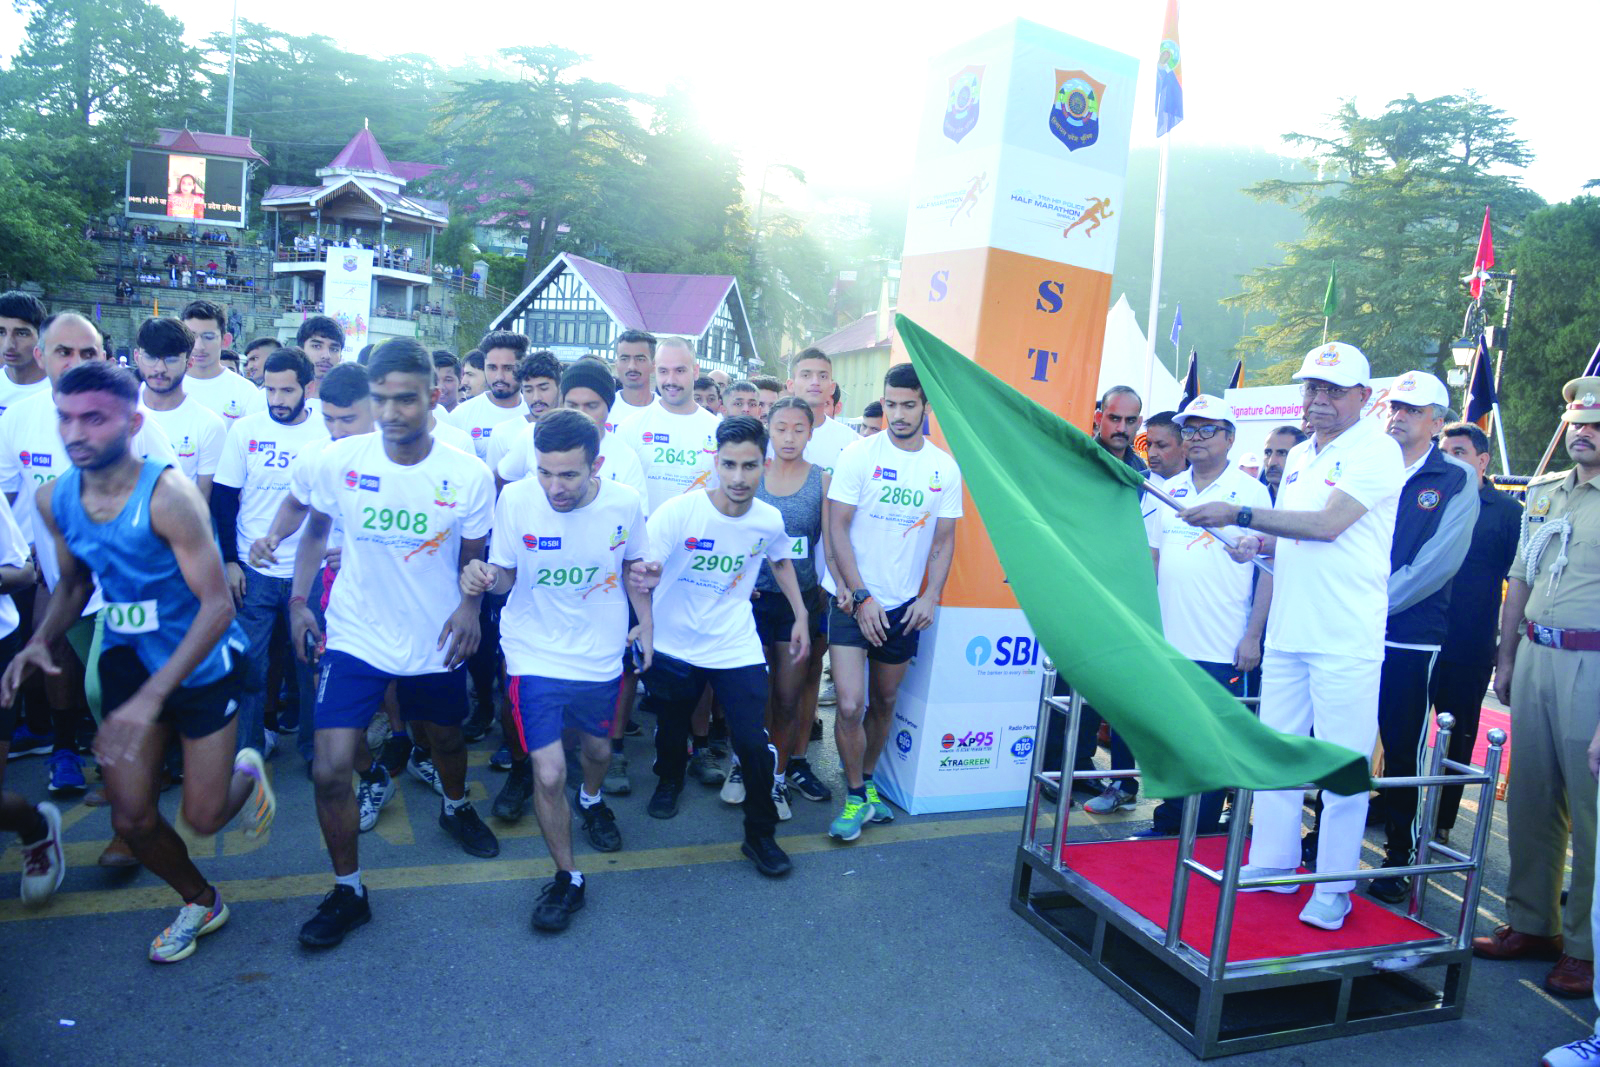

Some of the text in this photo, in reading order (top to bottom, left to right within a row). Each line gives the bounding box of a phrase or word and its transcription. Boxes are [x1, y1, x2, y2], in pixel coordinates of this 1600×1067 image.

[1010, 194, 1080, 217] HALF MARATHON
[1063, 200, 1085, 210] POLICE
[928, 270, 949, 302] S
[1028, 280, 1064, 382] S T
[654, 447, 697, 466] 2643
[879, 486, 924, 507] 2860
[363, 507, 428, 534] 2908
[792, 538, 803, 555] 4
[691, 555, 745, 573] 2905
[537, 567, 599, 586] 2907
[994, 636, 1039, 666] SBI
[1015, 743, 1031, 751] BIG
[940, 756, 990, 767] XTRAGREEN
